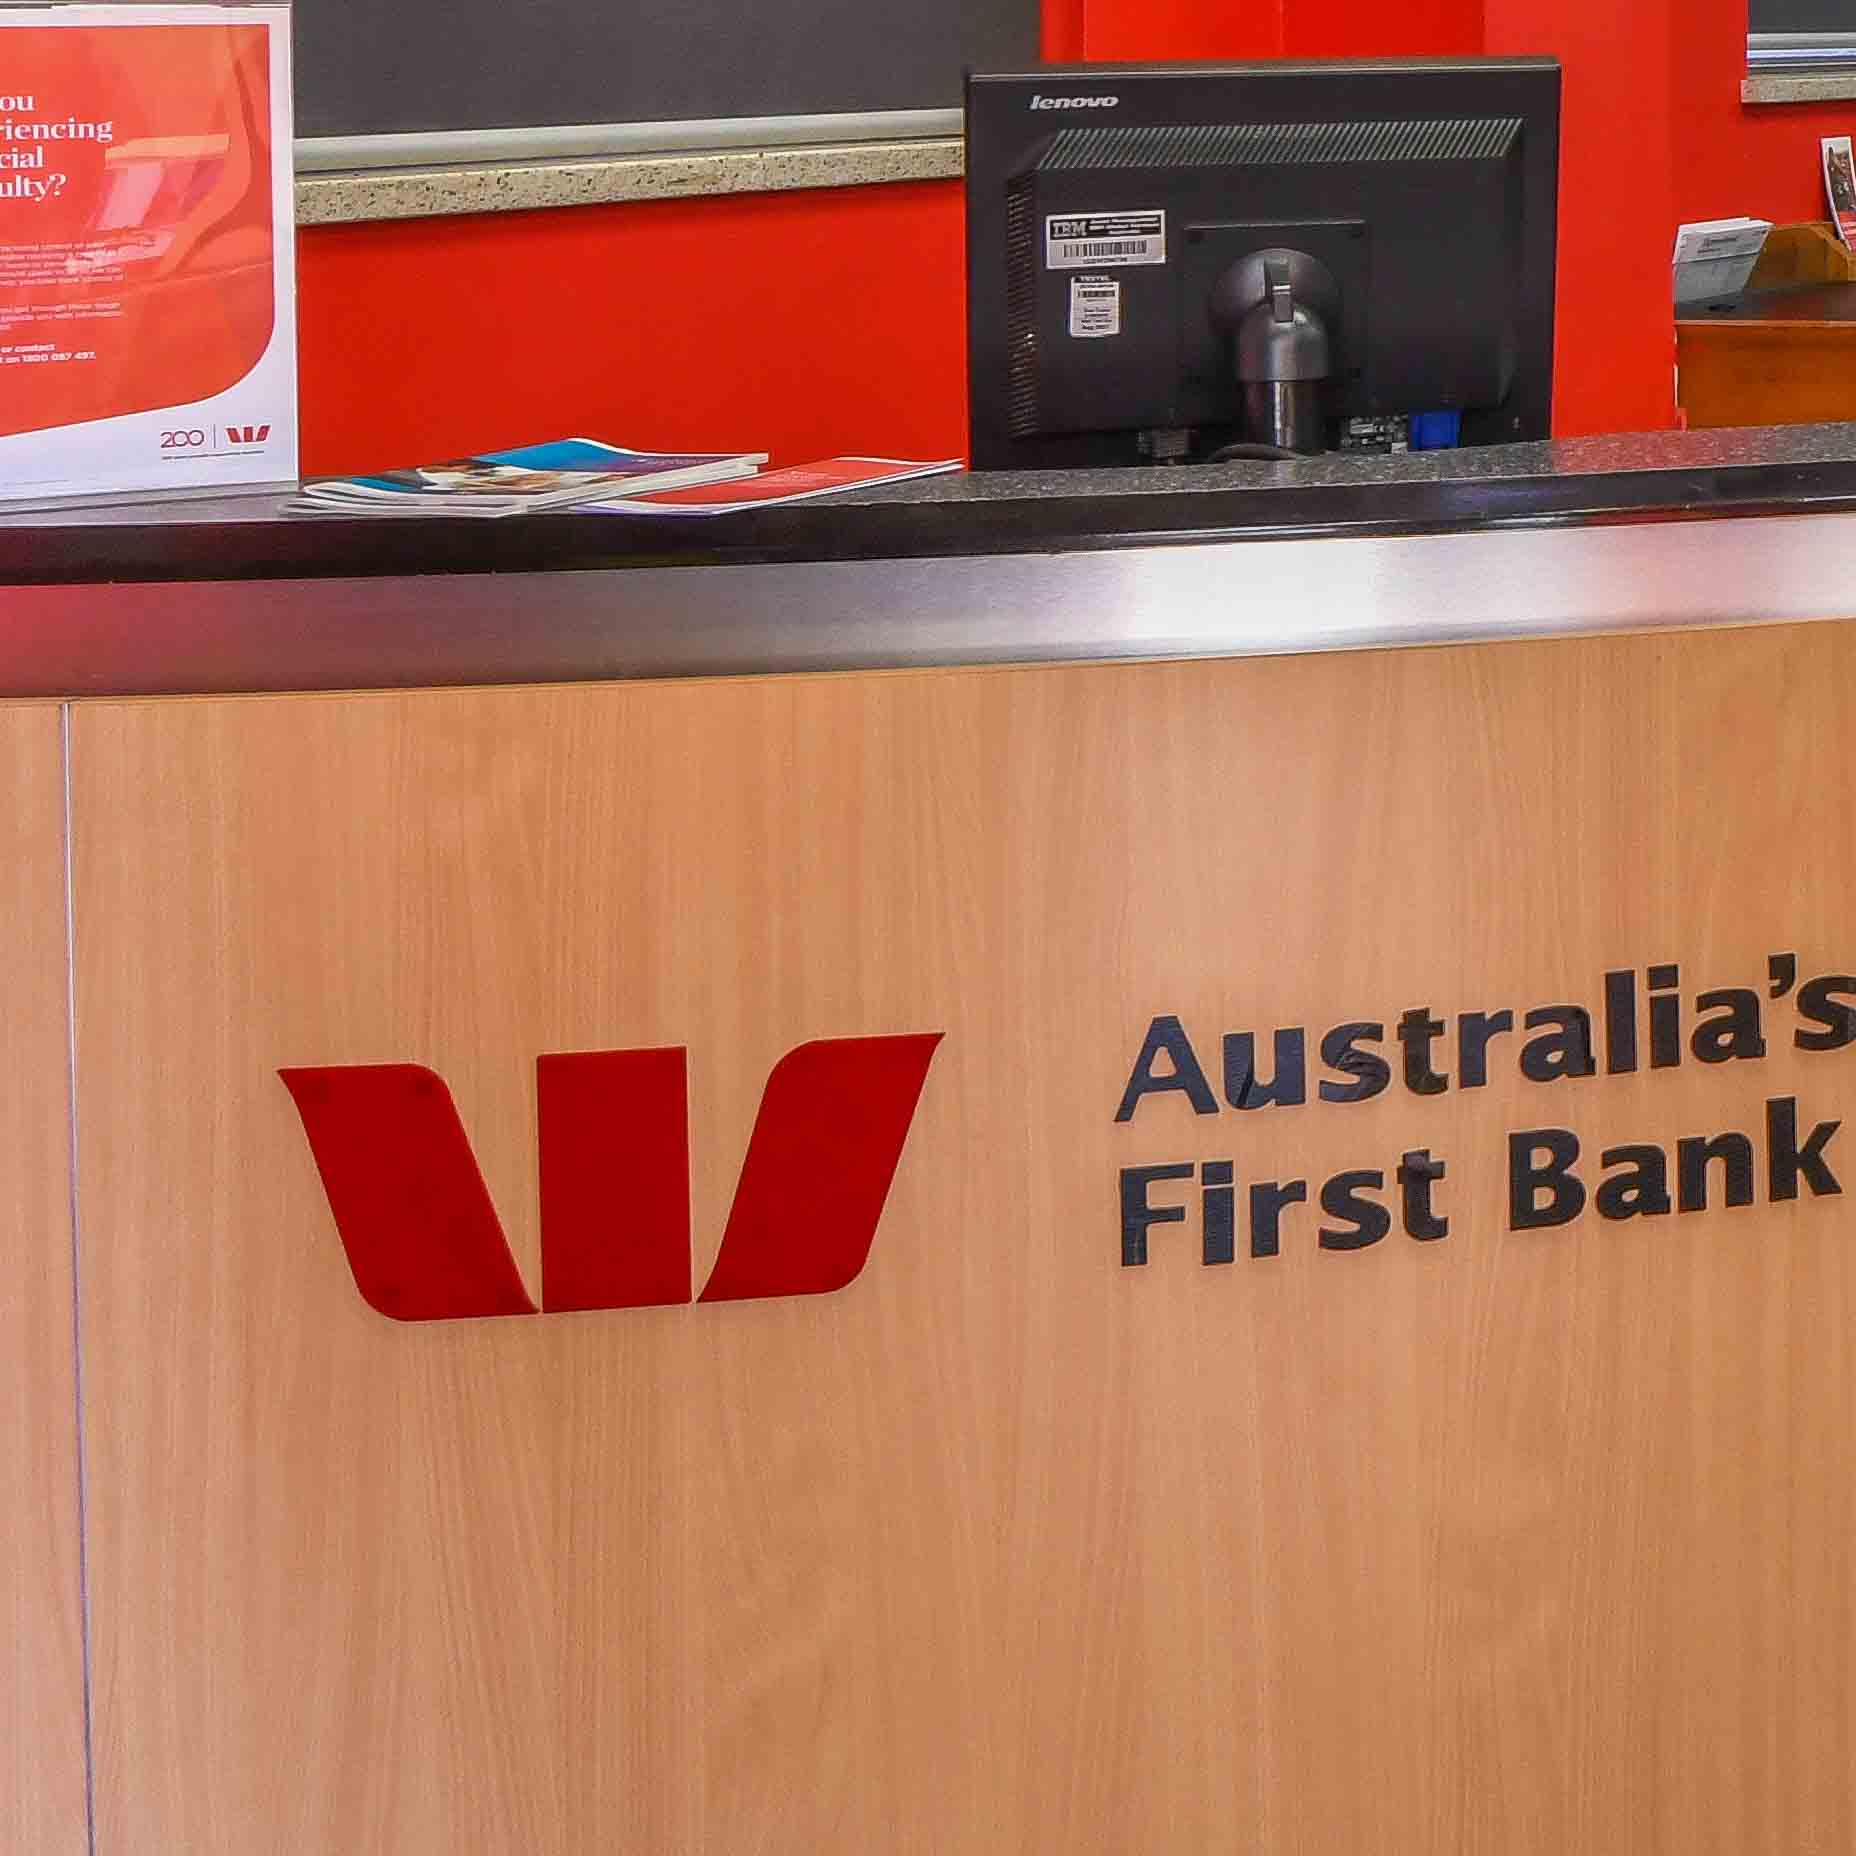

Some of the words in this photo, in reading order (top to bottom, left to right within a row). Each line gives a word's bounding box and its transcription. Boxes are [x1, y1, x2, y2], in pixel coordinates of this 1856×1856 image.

[0, 96, 35, 112] ou
[1030, 95, 1119, 110] lenovo
[1053, 221, 1088, 238] IBM
[160, 429, 205, 448] 200
[1120, 1149, 1450, 1268] First
[1508, 1097, 1844, 1232] Bank
